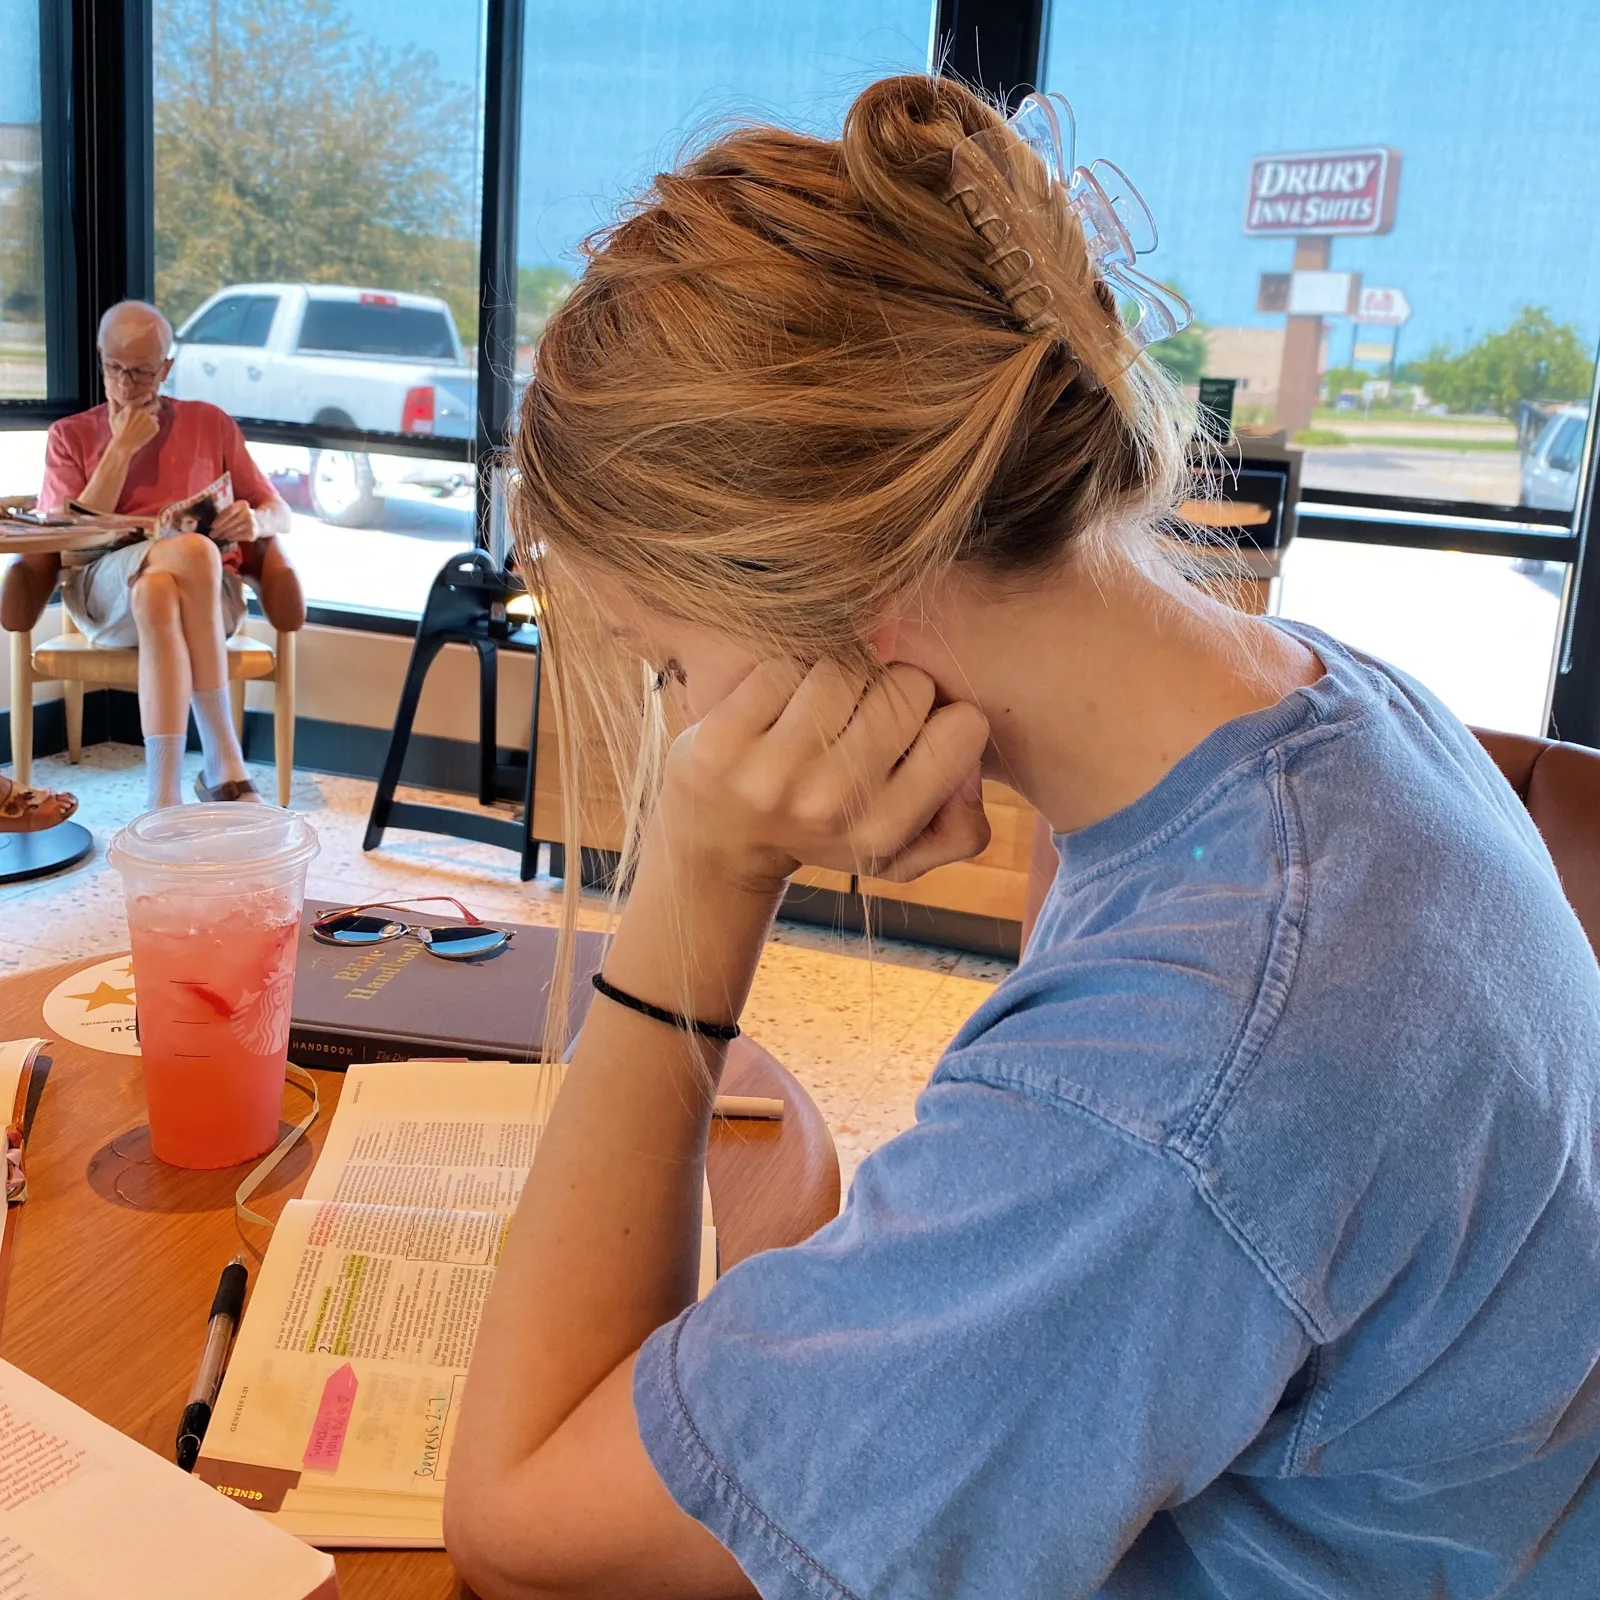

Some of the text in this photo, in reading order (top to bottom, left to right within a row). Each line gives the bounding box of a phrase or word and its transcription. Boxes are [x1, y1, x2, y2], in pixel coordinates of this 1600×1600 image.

[1258, 159, 1377, 198] DRURY
[293, 1041, 353, 1056] HANDBOOK
[318, 1346, 331, 1354] 2
[230, 1400, 245, 1433] GENESIS
[425, 1398, 446, 1421] 2:7
[414, 1425, 440, 1477] Genesis
[216, 1485, 263, 1501] GENESIS
